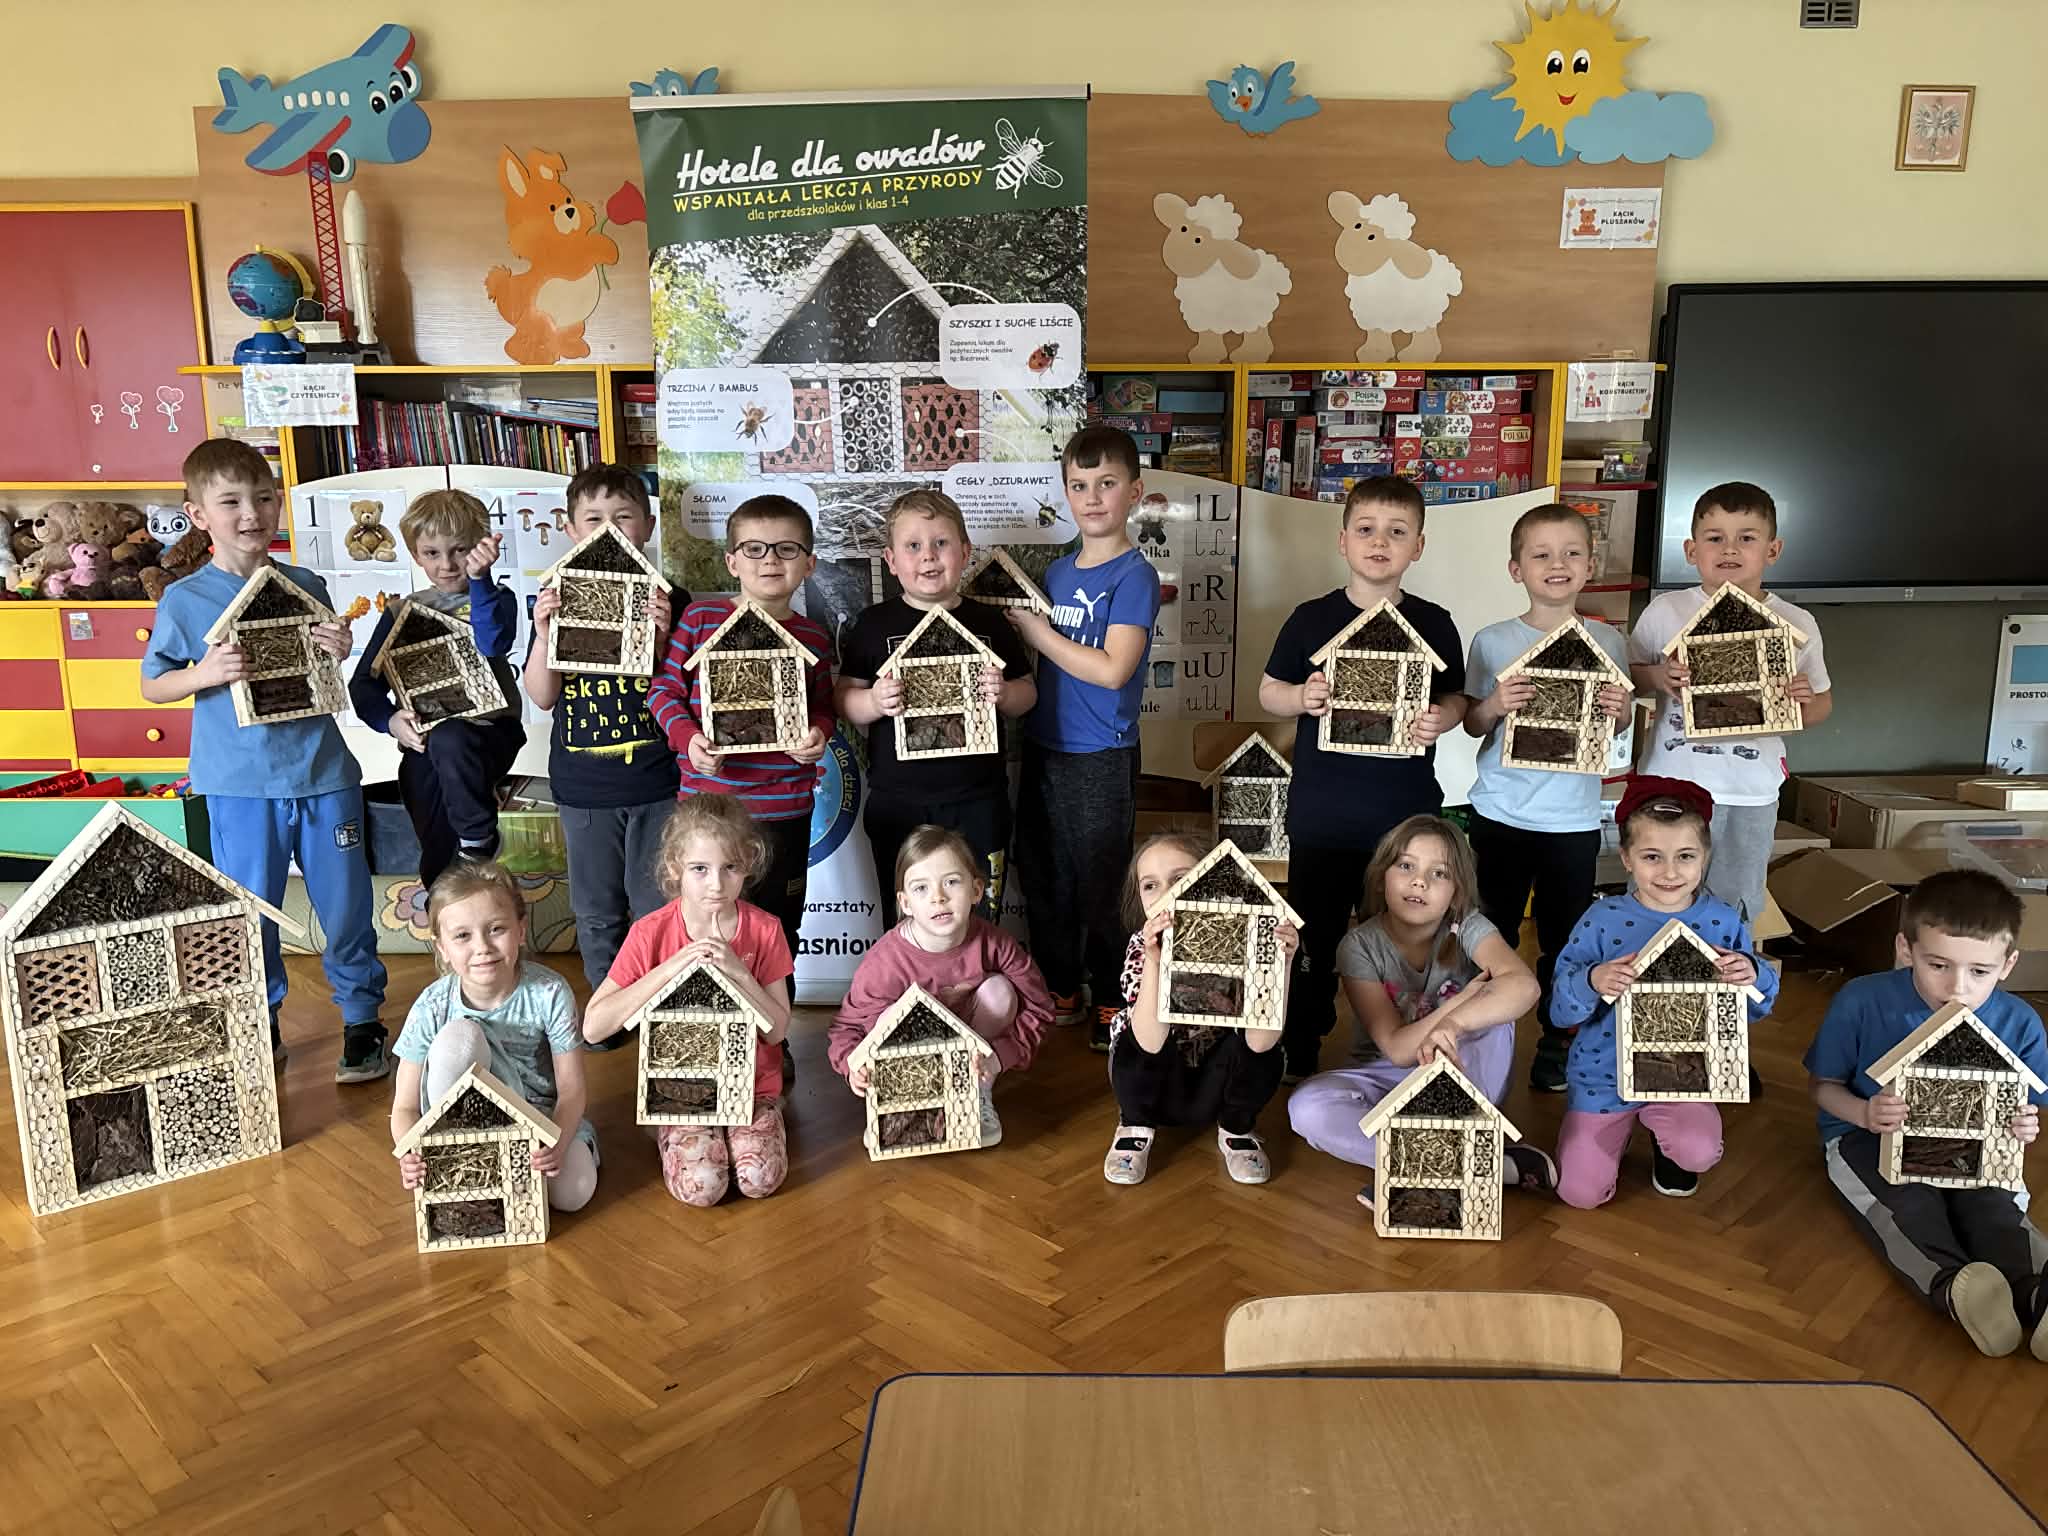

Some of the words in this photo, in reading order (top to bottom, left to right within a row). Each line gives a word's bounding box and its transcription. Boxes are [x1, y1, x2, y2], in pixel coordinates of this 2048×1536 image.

[677, 145, 779, 190] Hotele
[791, 139, 843, 177] dla
[855, 128, 986, 171] owadów
[673, 189, 791, 213] WSPANIAŁA
[801, 181, 873, 201] LEKCJA
[882, 169, 983, 193] PRZYRODY
[747, 208, 765, 221] dla
[768, 200, 856, 222] przedszkolaków
[859, 200, 863, 210] i
[866, 197, 888, 210] klas
[891, 194, 909, 207] 1-4
[1613, 210, 1634, 218] KĄCIK
[1600, 217, 1645, 225] PLUSZAKÓW
[949, 319, 992, 328] SZYSZKI
[995, 319, 1000, 328] I
[1004, 318, 1037, 328] SUCHE
[1040, 316, 1073, 327] LIŚCIE
[303, 384, 326, 392] KĄCIK
[666, 384, 707, 393] TRZCINA
[719, 384, 759, 392] BAMBUS
[1503, 431, 1529, 441] POLSKA
[955, 476, 985, 486] CEGŁY
[693, 495, 727, 503] SŁOMA
[307, 495, 321, 527] 1
[488, 496, 508, 526] 4
[1137, 546, 1170, 558] lka
[1051, 604, 1085, 628] UMA
[564, 676, 650, 700] skate
[2009, 691, 2048, 699] PROSTO
